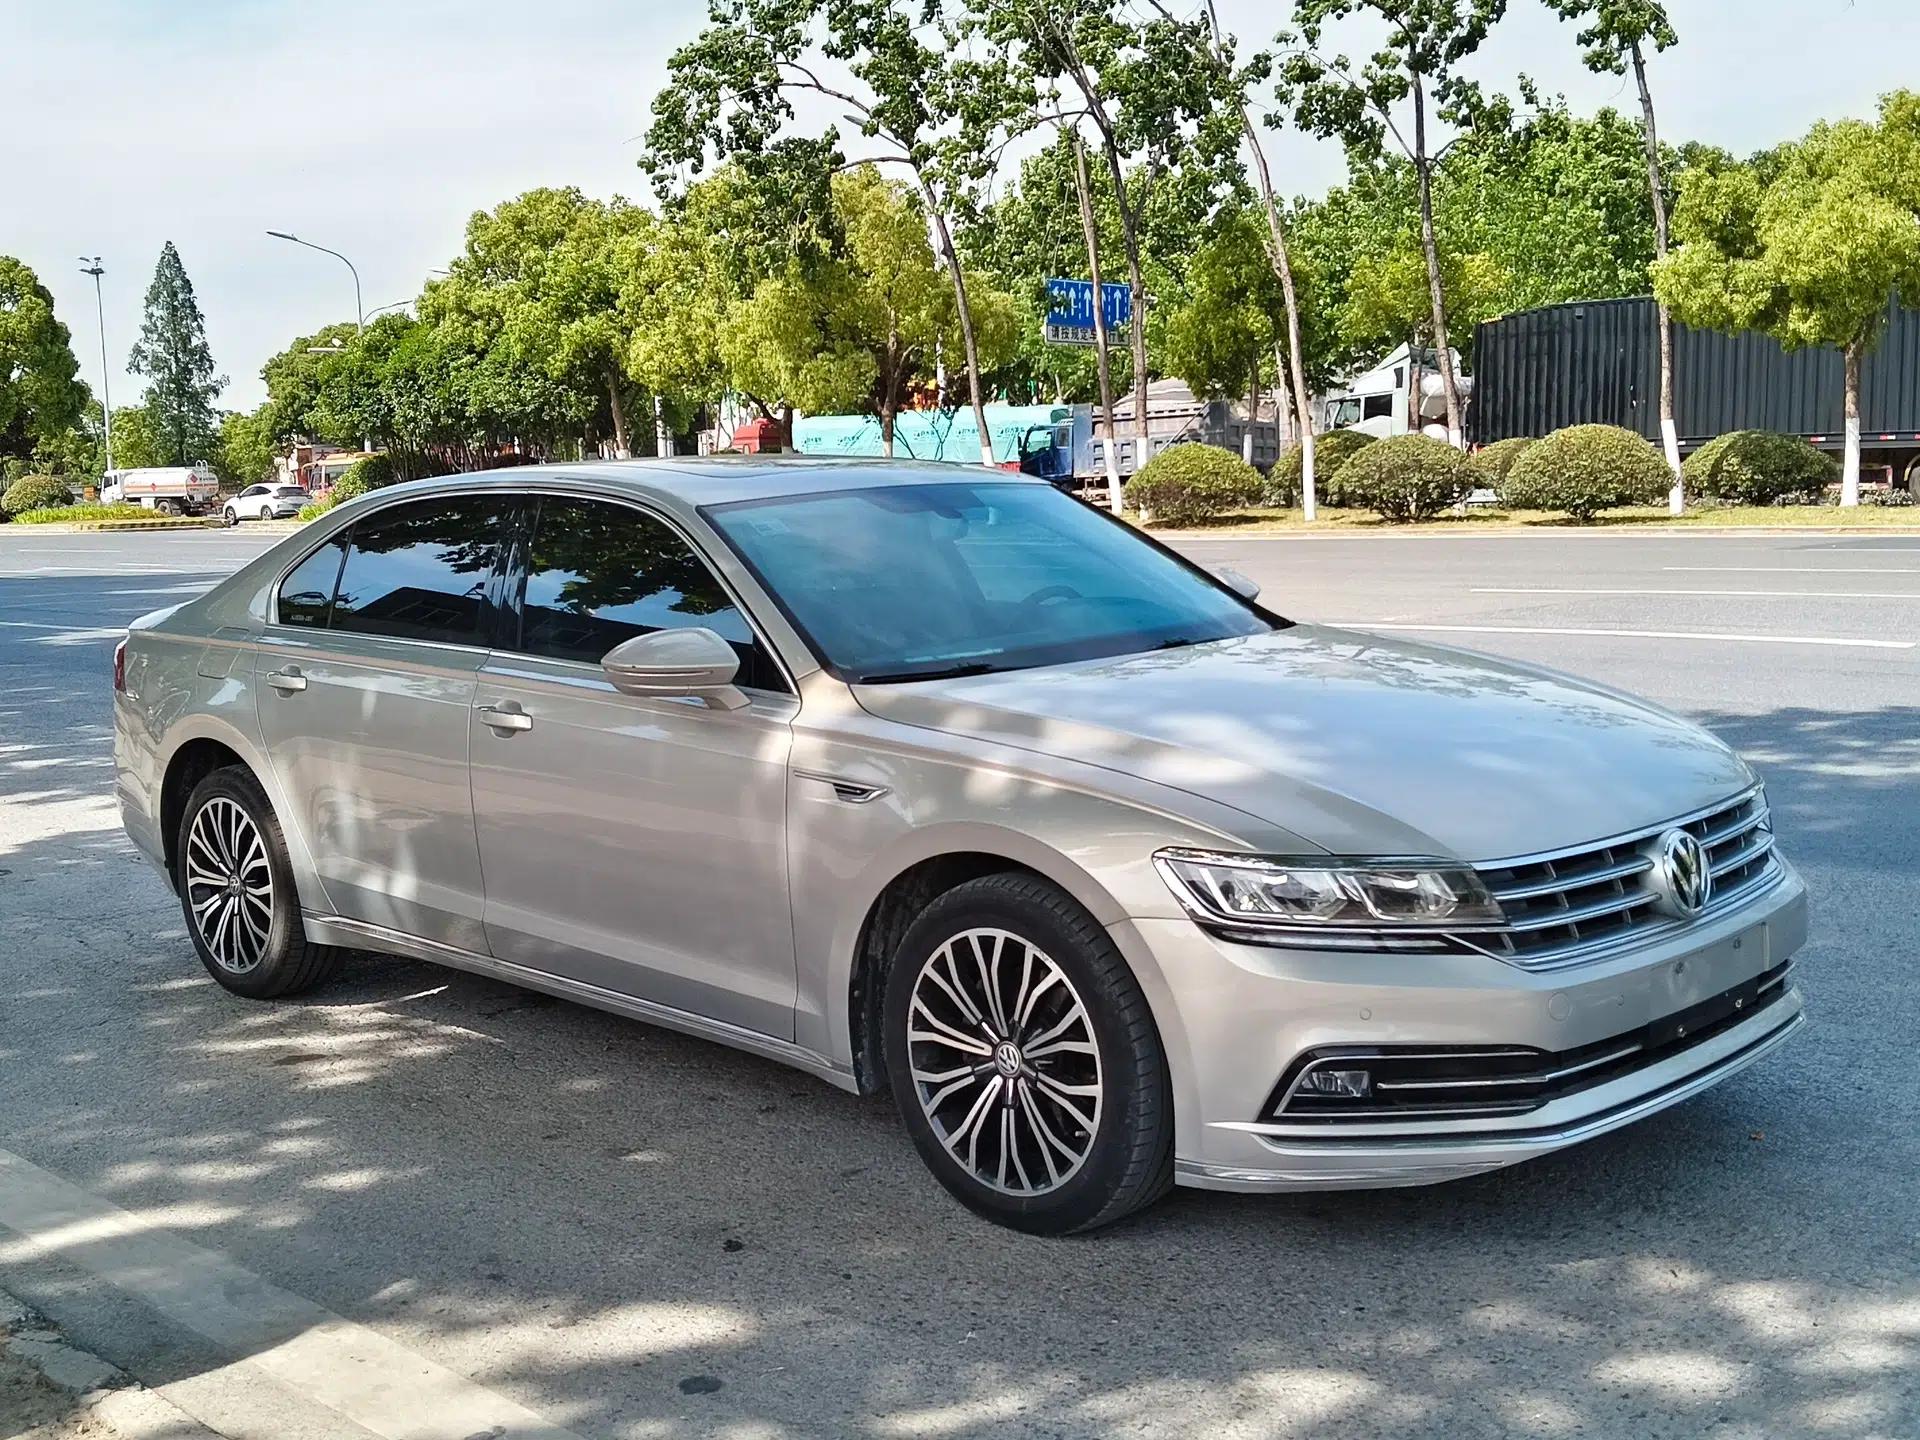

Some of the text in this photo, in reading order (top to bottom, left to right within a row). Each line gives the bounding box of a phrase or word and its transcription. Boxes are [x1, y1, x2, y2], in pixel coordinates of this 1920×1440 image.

[1052, 326, 1125, 342] 请按规定车行
[1664, 831, 1710, 915] VW
[997, 1043, 1020, 1075] VW
